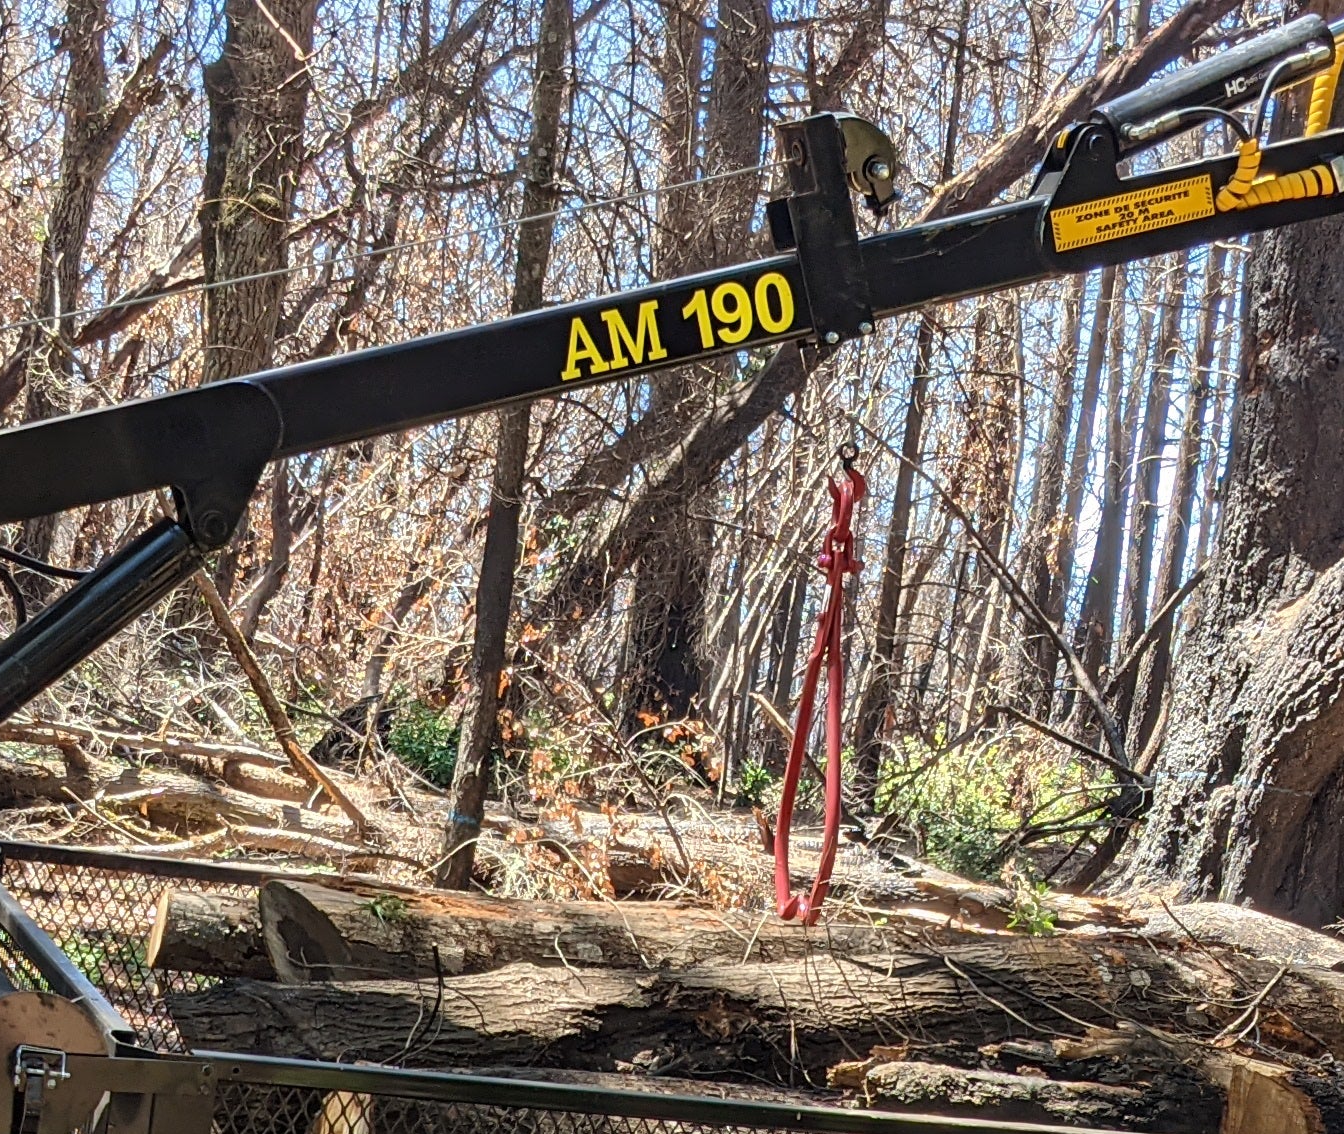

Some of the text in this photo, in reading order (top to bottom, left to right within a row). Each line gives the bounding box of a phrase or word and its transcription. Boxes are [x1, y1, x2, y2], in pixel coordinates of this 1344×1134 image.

[1075, 210, 1110, 223] ZONE
[1114, 205, 1130, 213] DE
[1095, 209, 1175, 234] SAFETY AREA
[1119, 207, 1150, 221] 20 M
[561, 272, 794, 381] AM 190
